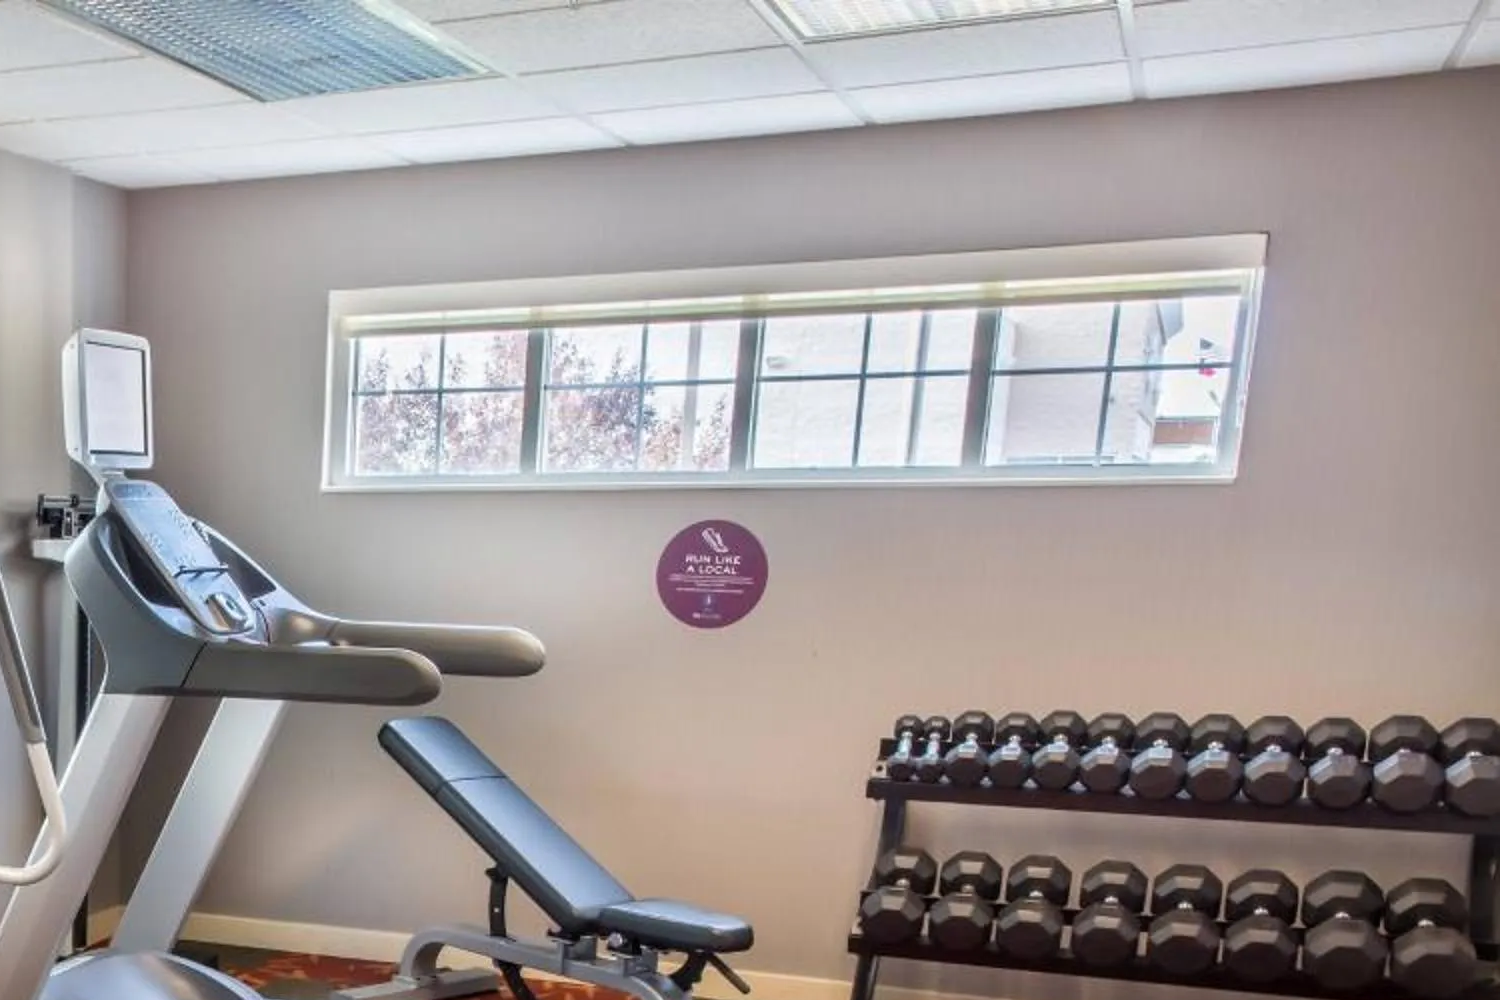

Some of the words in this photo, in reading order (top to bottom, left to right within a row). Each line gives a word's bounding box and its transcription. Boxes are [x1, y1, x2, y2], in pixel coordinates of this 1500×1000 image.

[685, 555, 711, 564] RUN
[715, 555, 741, 565] LIKE
[686, 565, 695, 573] A
[699, 565, 737, 575] LOCAL
